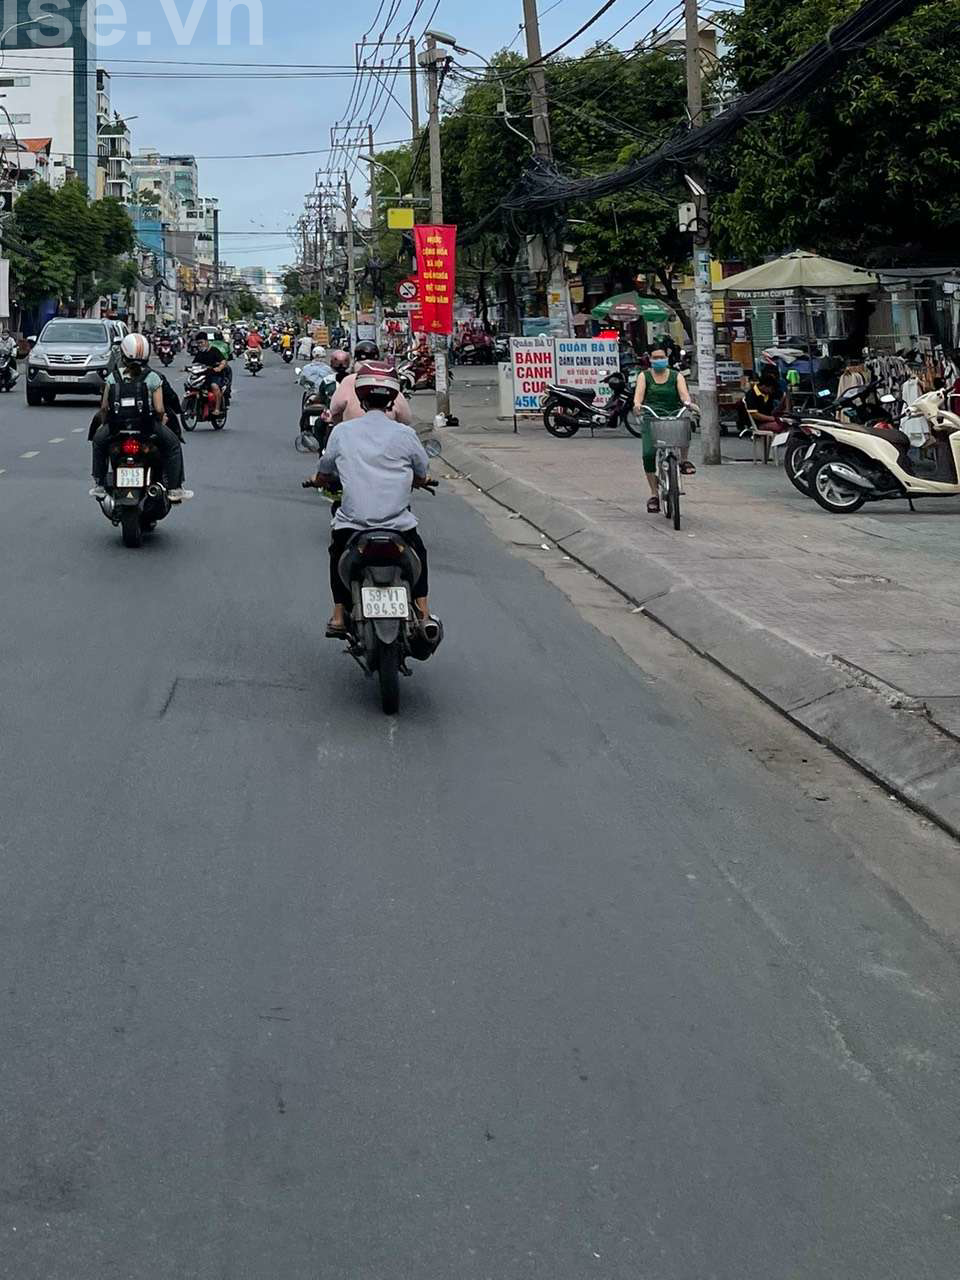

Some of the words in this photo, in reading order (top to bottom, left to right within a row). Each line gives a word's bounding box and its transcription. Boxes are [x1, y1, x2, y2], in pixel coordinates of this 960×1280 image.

[515, 350, 552, 365] BÁNH
[516, 367, 553, 379] CANH
[515, 395, 538, 408] 45K
